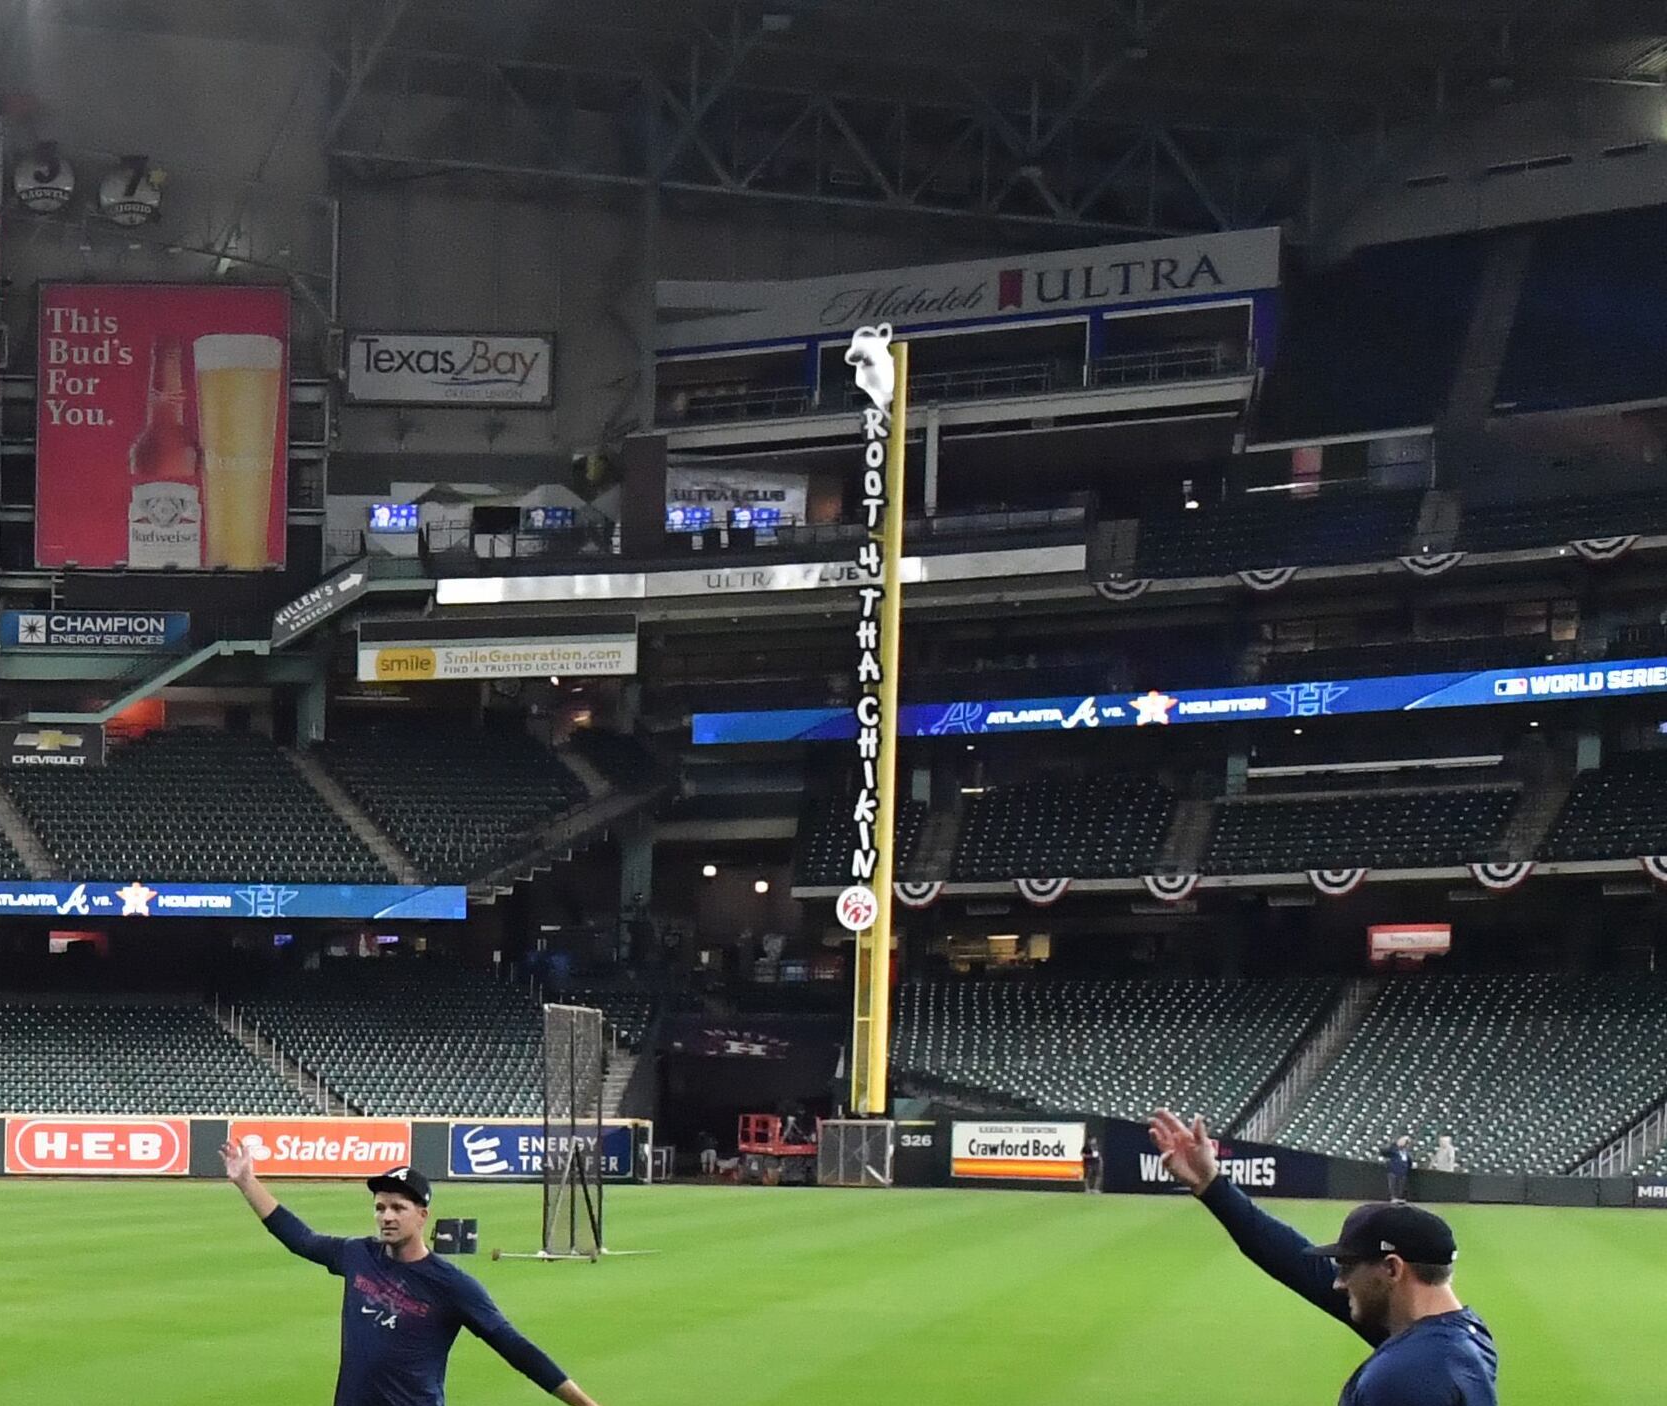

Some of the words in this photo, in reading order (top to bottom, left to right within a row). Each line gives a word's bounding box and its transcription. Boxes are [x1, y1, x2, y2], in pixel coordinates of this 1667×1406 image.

[819, 280, 988, 327] Michelob
[1036, 253, 1224, 303] ULTRA
[46, 307, 118, 334] This
[46, 337, 134, 366] Bud's
[46, 369, 100, 395] For
[444, 389, 481, 399] CREDIT
[484, 389, 523, 398] UNION
[46, 398, 115, 426] You.
[862, 408, 886, 528] ROOT
[131, 530, 200, 545] Budweiser
[857, 544, 881, 576] 4
[274, 583, 335, 627] KILLEN'S
[49, 615, 165, 633] CHAMPION
[289, 602, 334, 632] BARBECUE
[49, 634, 102, 645] ENERGY
[102, 634, 165, 645] SERVICES
[380, 655, 432, 674] smile
[443, 647, 622, 665] SmileGeneration.com
[443, 665, 466, 674] FIND
[482, 663, 533, 673] TRUSTED
[534, 661, 572, 672] LOCAL
[574, 660, 621, 671] DENTIST
[1530, 671, 1604, 695] WORLD
[1606, 667, 1667, 690] SERIE
[985, 707, 1063, 724] ATLANTA
[1178, 698, 1267, 715] HOUSTON
[11, 754, 86, 766] CHEVROLET
[852, 696, 880, 879] CHIKIN
[157, 895, 232, 908] HOUSTON
[33, 1133, 162, 1161] H-E-B
[518, 1135, 599, 1153] ENERGY
[900, 1134, 933, 1147] 326
[968, 1138, 1032, 1158] Crawford
[1032, 1138, 1067, 1158] Bock
